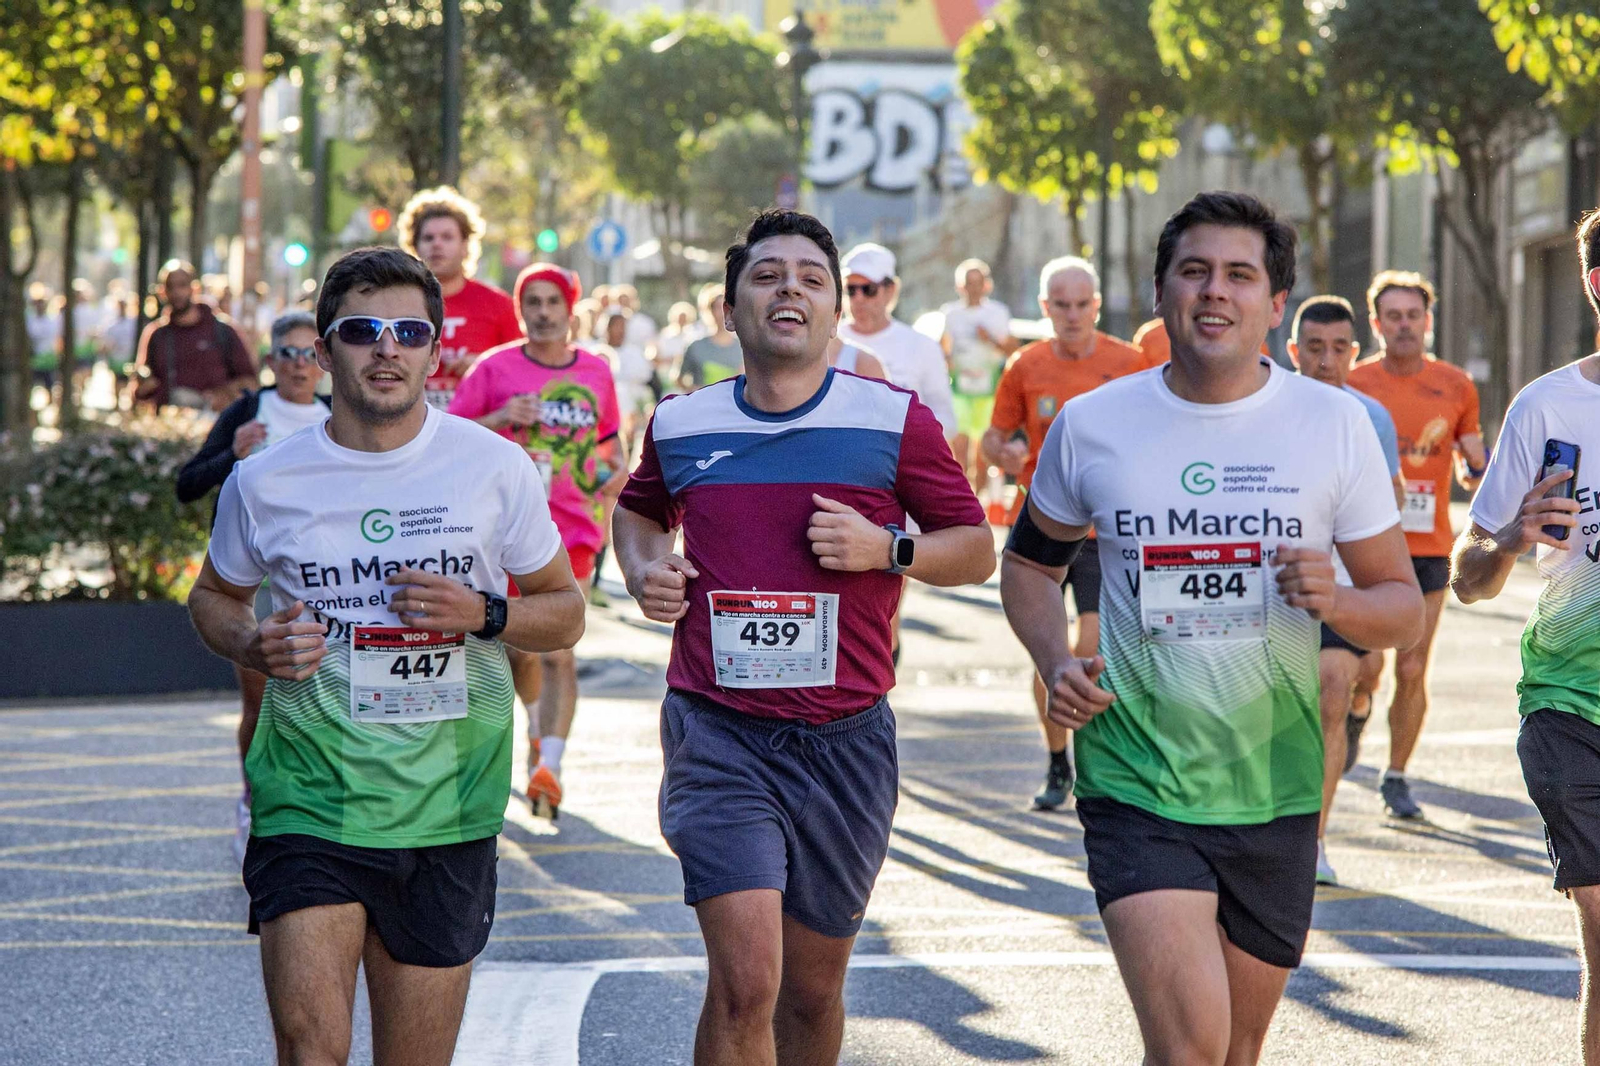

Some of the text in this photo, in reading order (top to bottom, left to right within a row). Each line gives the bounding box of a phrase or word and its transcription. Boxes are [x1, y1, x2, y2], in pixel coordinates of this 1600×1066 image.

[1223, 463, 1275, 473] asociación
[1223, 474, 1268, 485] española
[1222, 484, 1300, 494] contra el cáncer
[399, 505, 448, 517] asociación
[400, 517, 443, 529] española
[1115, 508, 1303, 539] En Marcha
[400, 524, 474, 538] contra el cáncer
[300, 549, 474, 588] En Marcha
[1180, 572, 1247, 600] 484
[305, 589, 387, 611] contra el
[720, 610, 732, 618] Vigo
[739, 621, 800, 647] 439
[364, 644, 379, 652] Vigo
[388, 644, 412, 652] marcha
[412, 643, 432, 651] contra
[437, 641, 457, 649] cancro
[390, 651, 451, 680] 447
